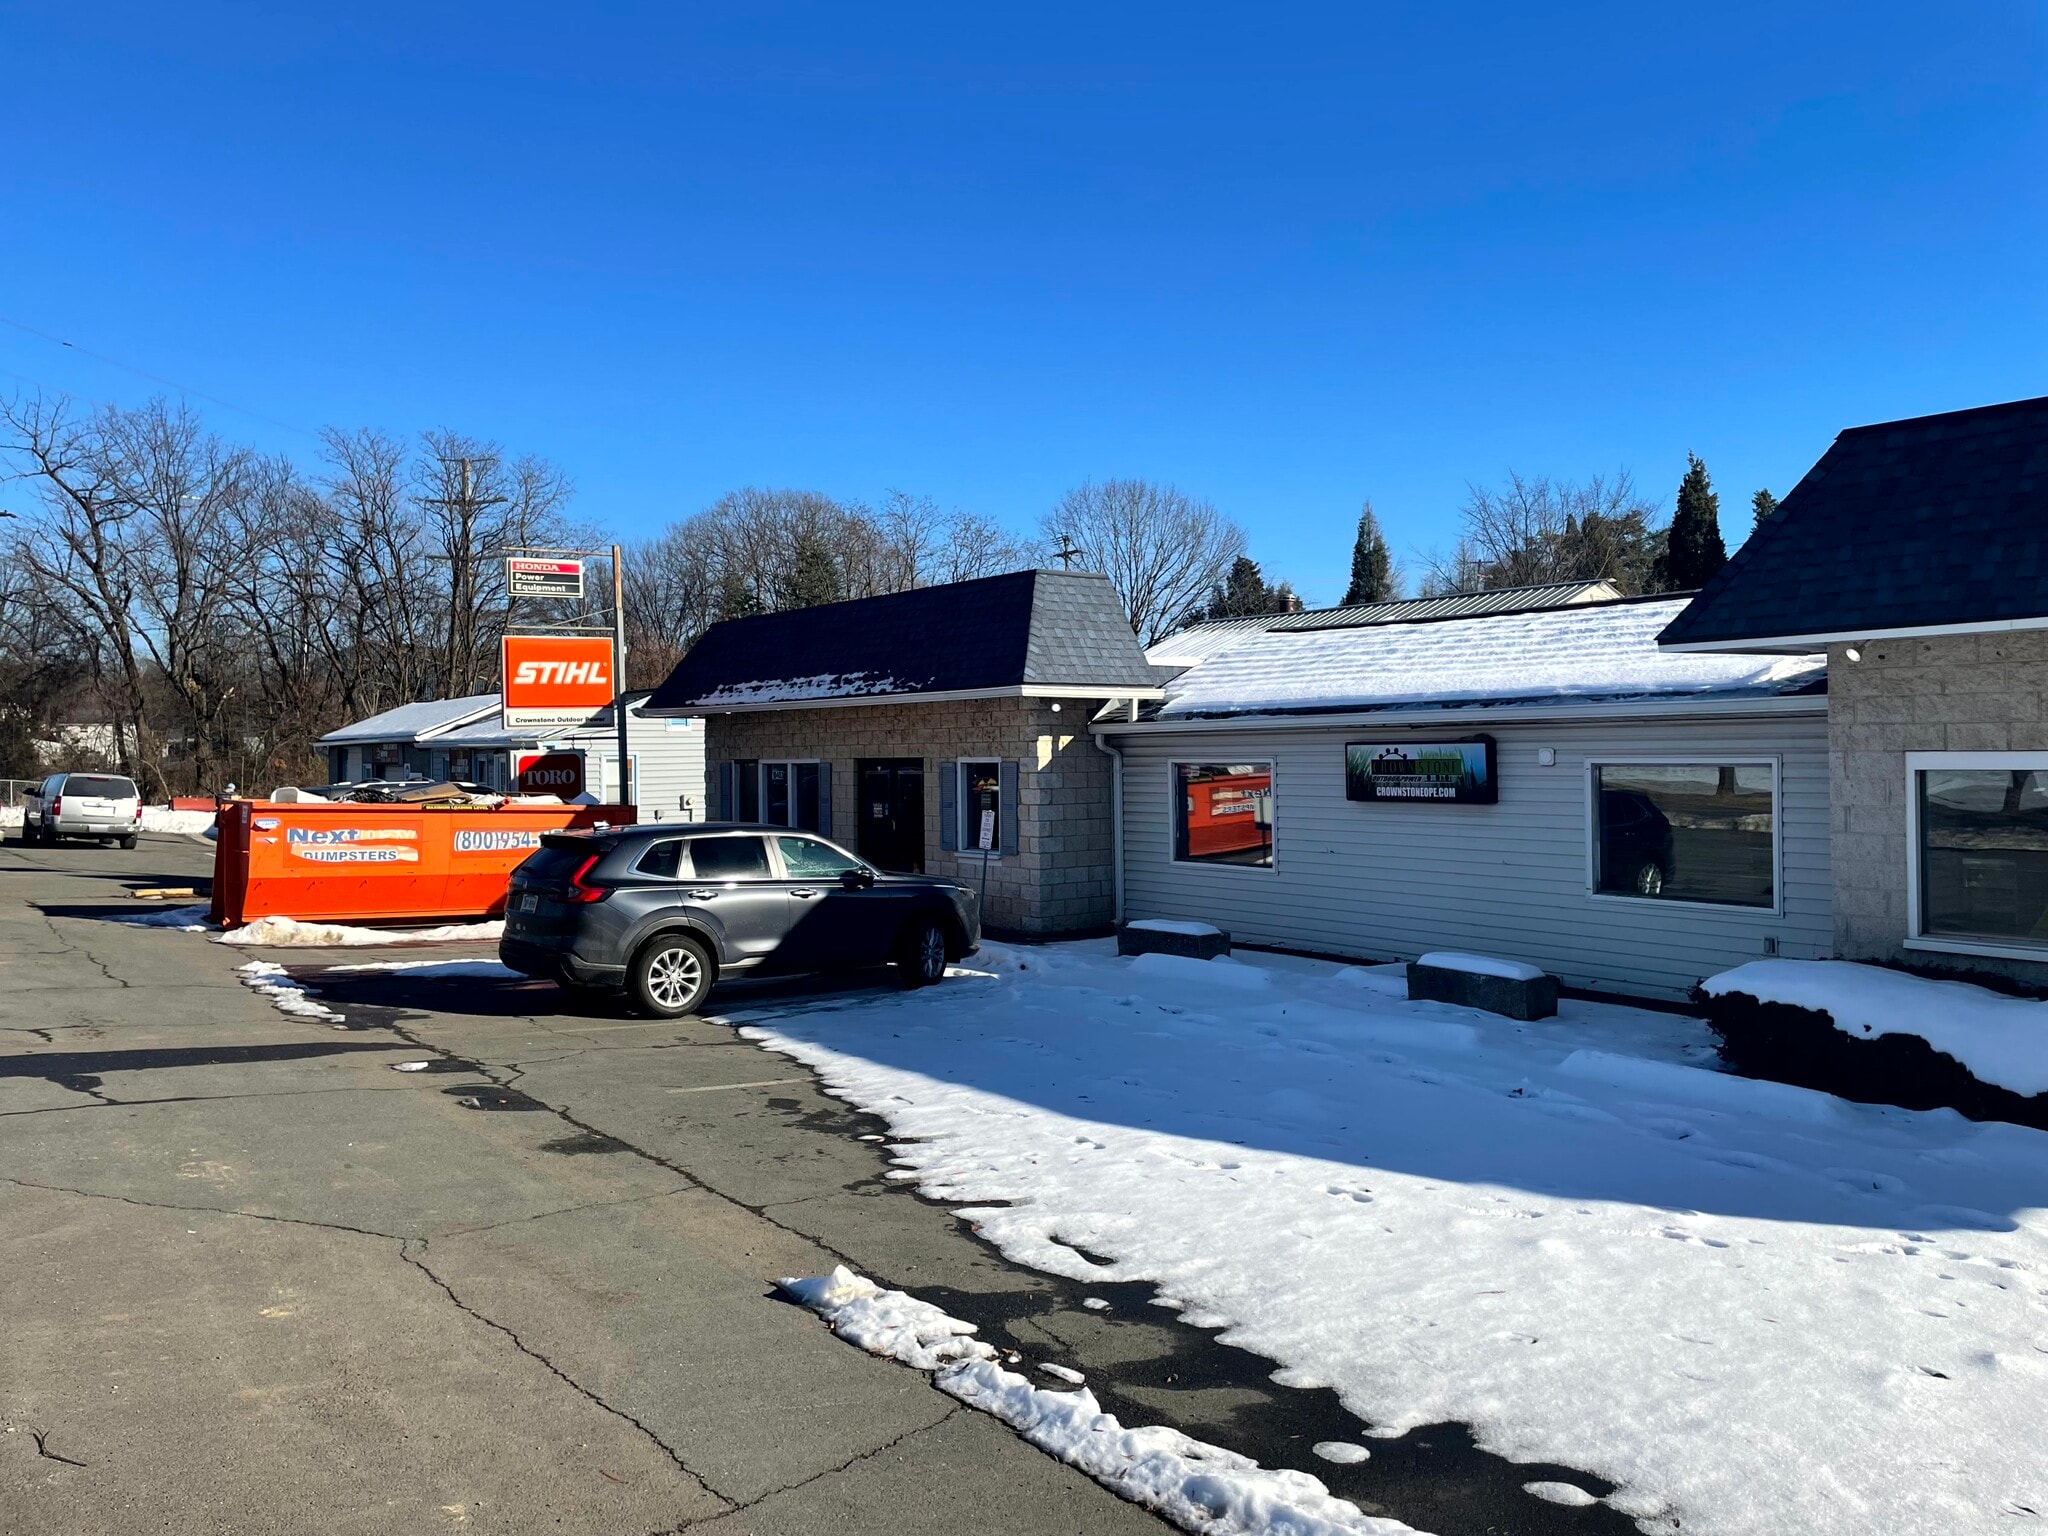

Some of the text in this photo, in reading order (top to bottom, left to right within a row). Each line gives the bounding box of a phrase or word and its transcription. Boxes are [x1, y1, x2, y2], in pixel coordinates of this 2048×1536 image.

[515, 562, 560, 571] HONDA
[515, 573, 545, 581] Power
[515, 583, 566, 592] Equipment
[513, 661, 607, 685] STIHL
[1372, 760, 1457, 774] CROWNSTONE
[521, 769, 576, 786] TORO
[1376, 786, 1456, 798] CROWNSTONEOPE.COM
[288, 828, 358, 844] Next
[304, 850, 397, 861] DUMPSTERS
